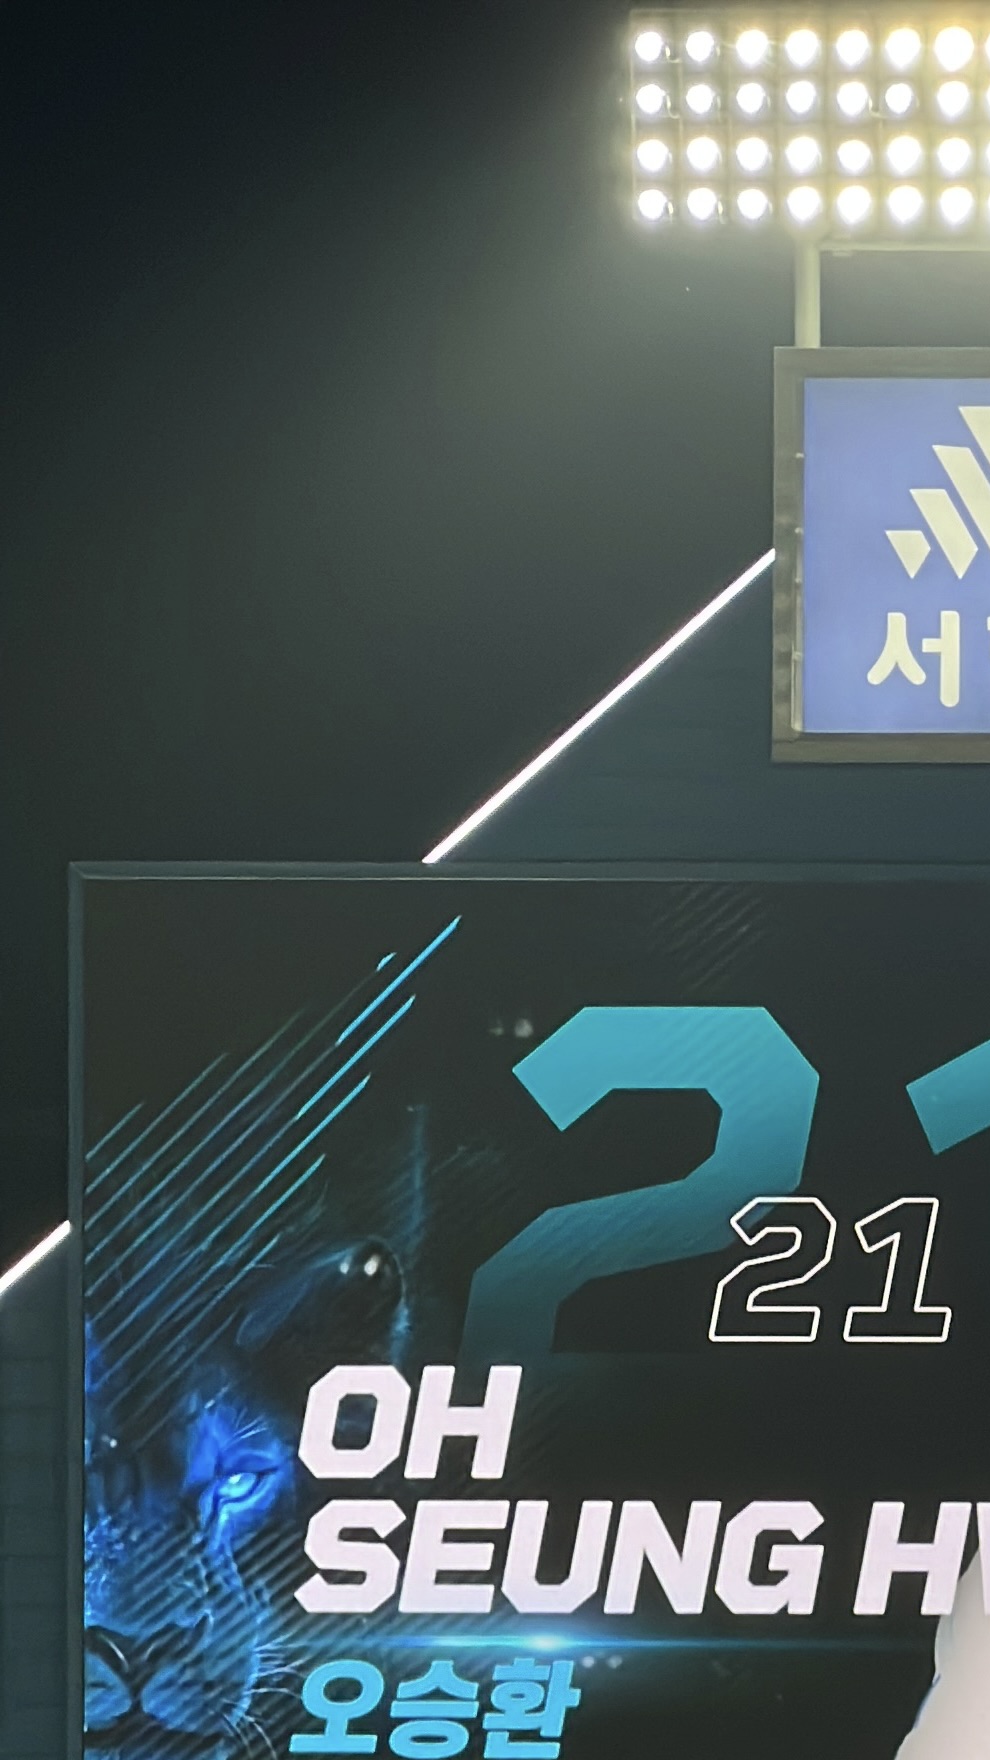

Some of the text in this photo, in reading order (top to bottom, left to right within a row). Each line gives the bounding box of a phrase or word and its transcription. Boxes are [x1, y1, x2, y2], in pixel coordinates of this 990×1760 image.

[708, 1196, 952, 1342] 21
[298, 1365, 522, 1479] OH
[294, 1500, 825, 1615] SEUNG
[289, 1658, 582, 1760] 오승환
